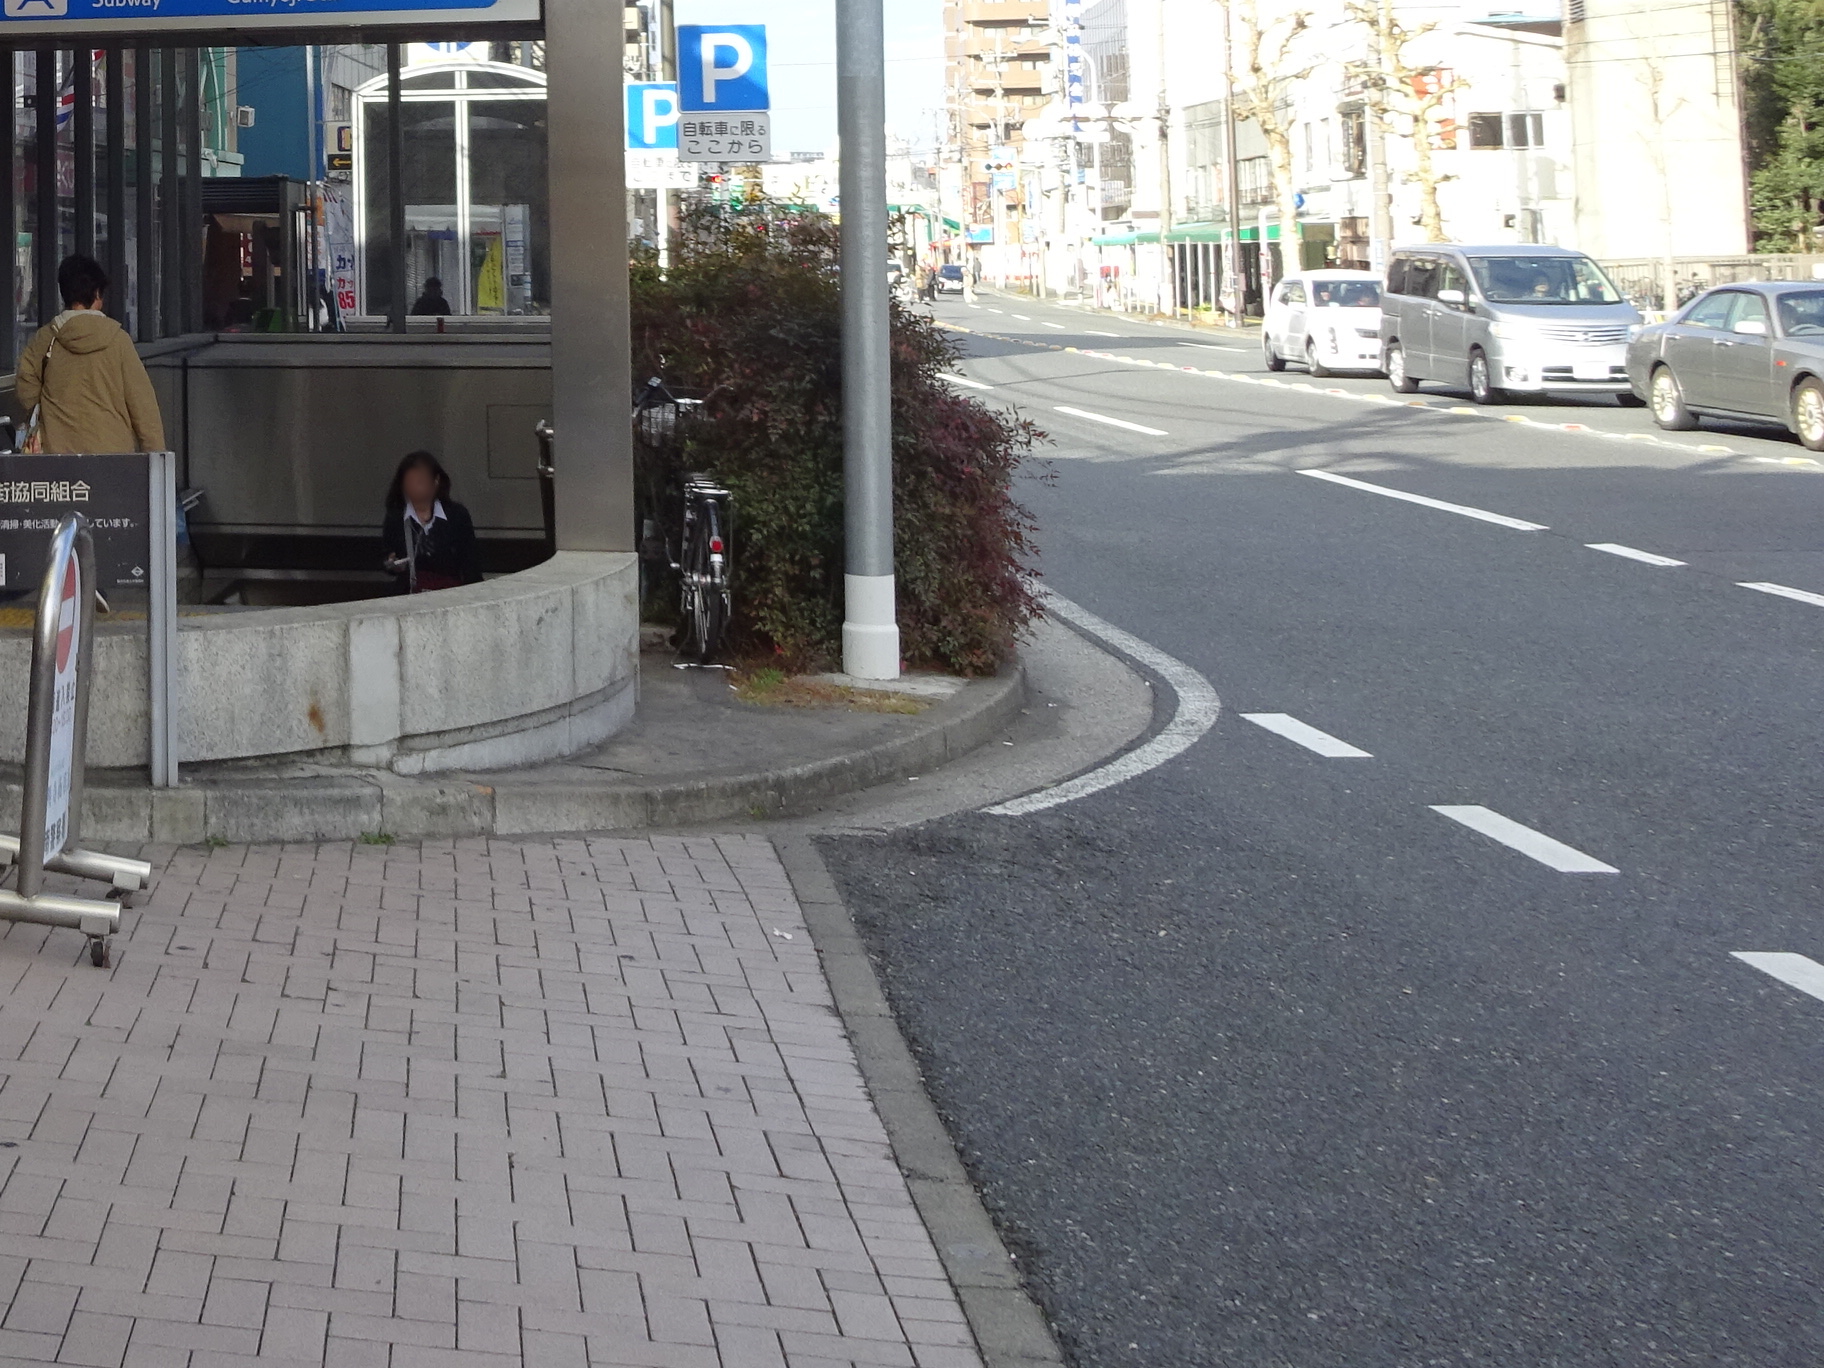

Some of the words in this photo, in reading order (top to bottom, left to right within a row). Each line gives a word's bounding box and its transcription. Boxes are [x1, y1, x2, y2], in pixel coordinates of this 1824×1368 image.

[700, 32, 754, 103] P
[642, 88, 678, 145] P
[683, 120, 767, 137] 自転車に限る
[687, 139, 764, 155] ここから
